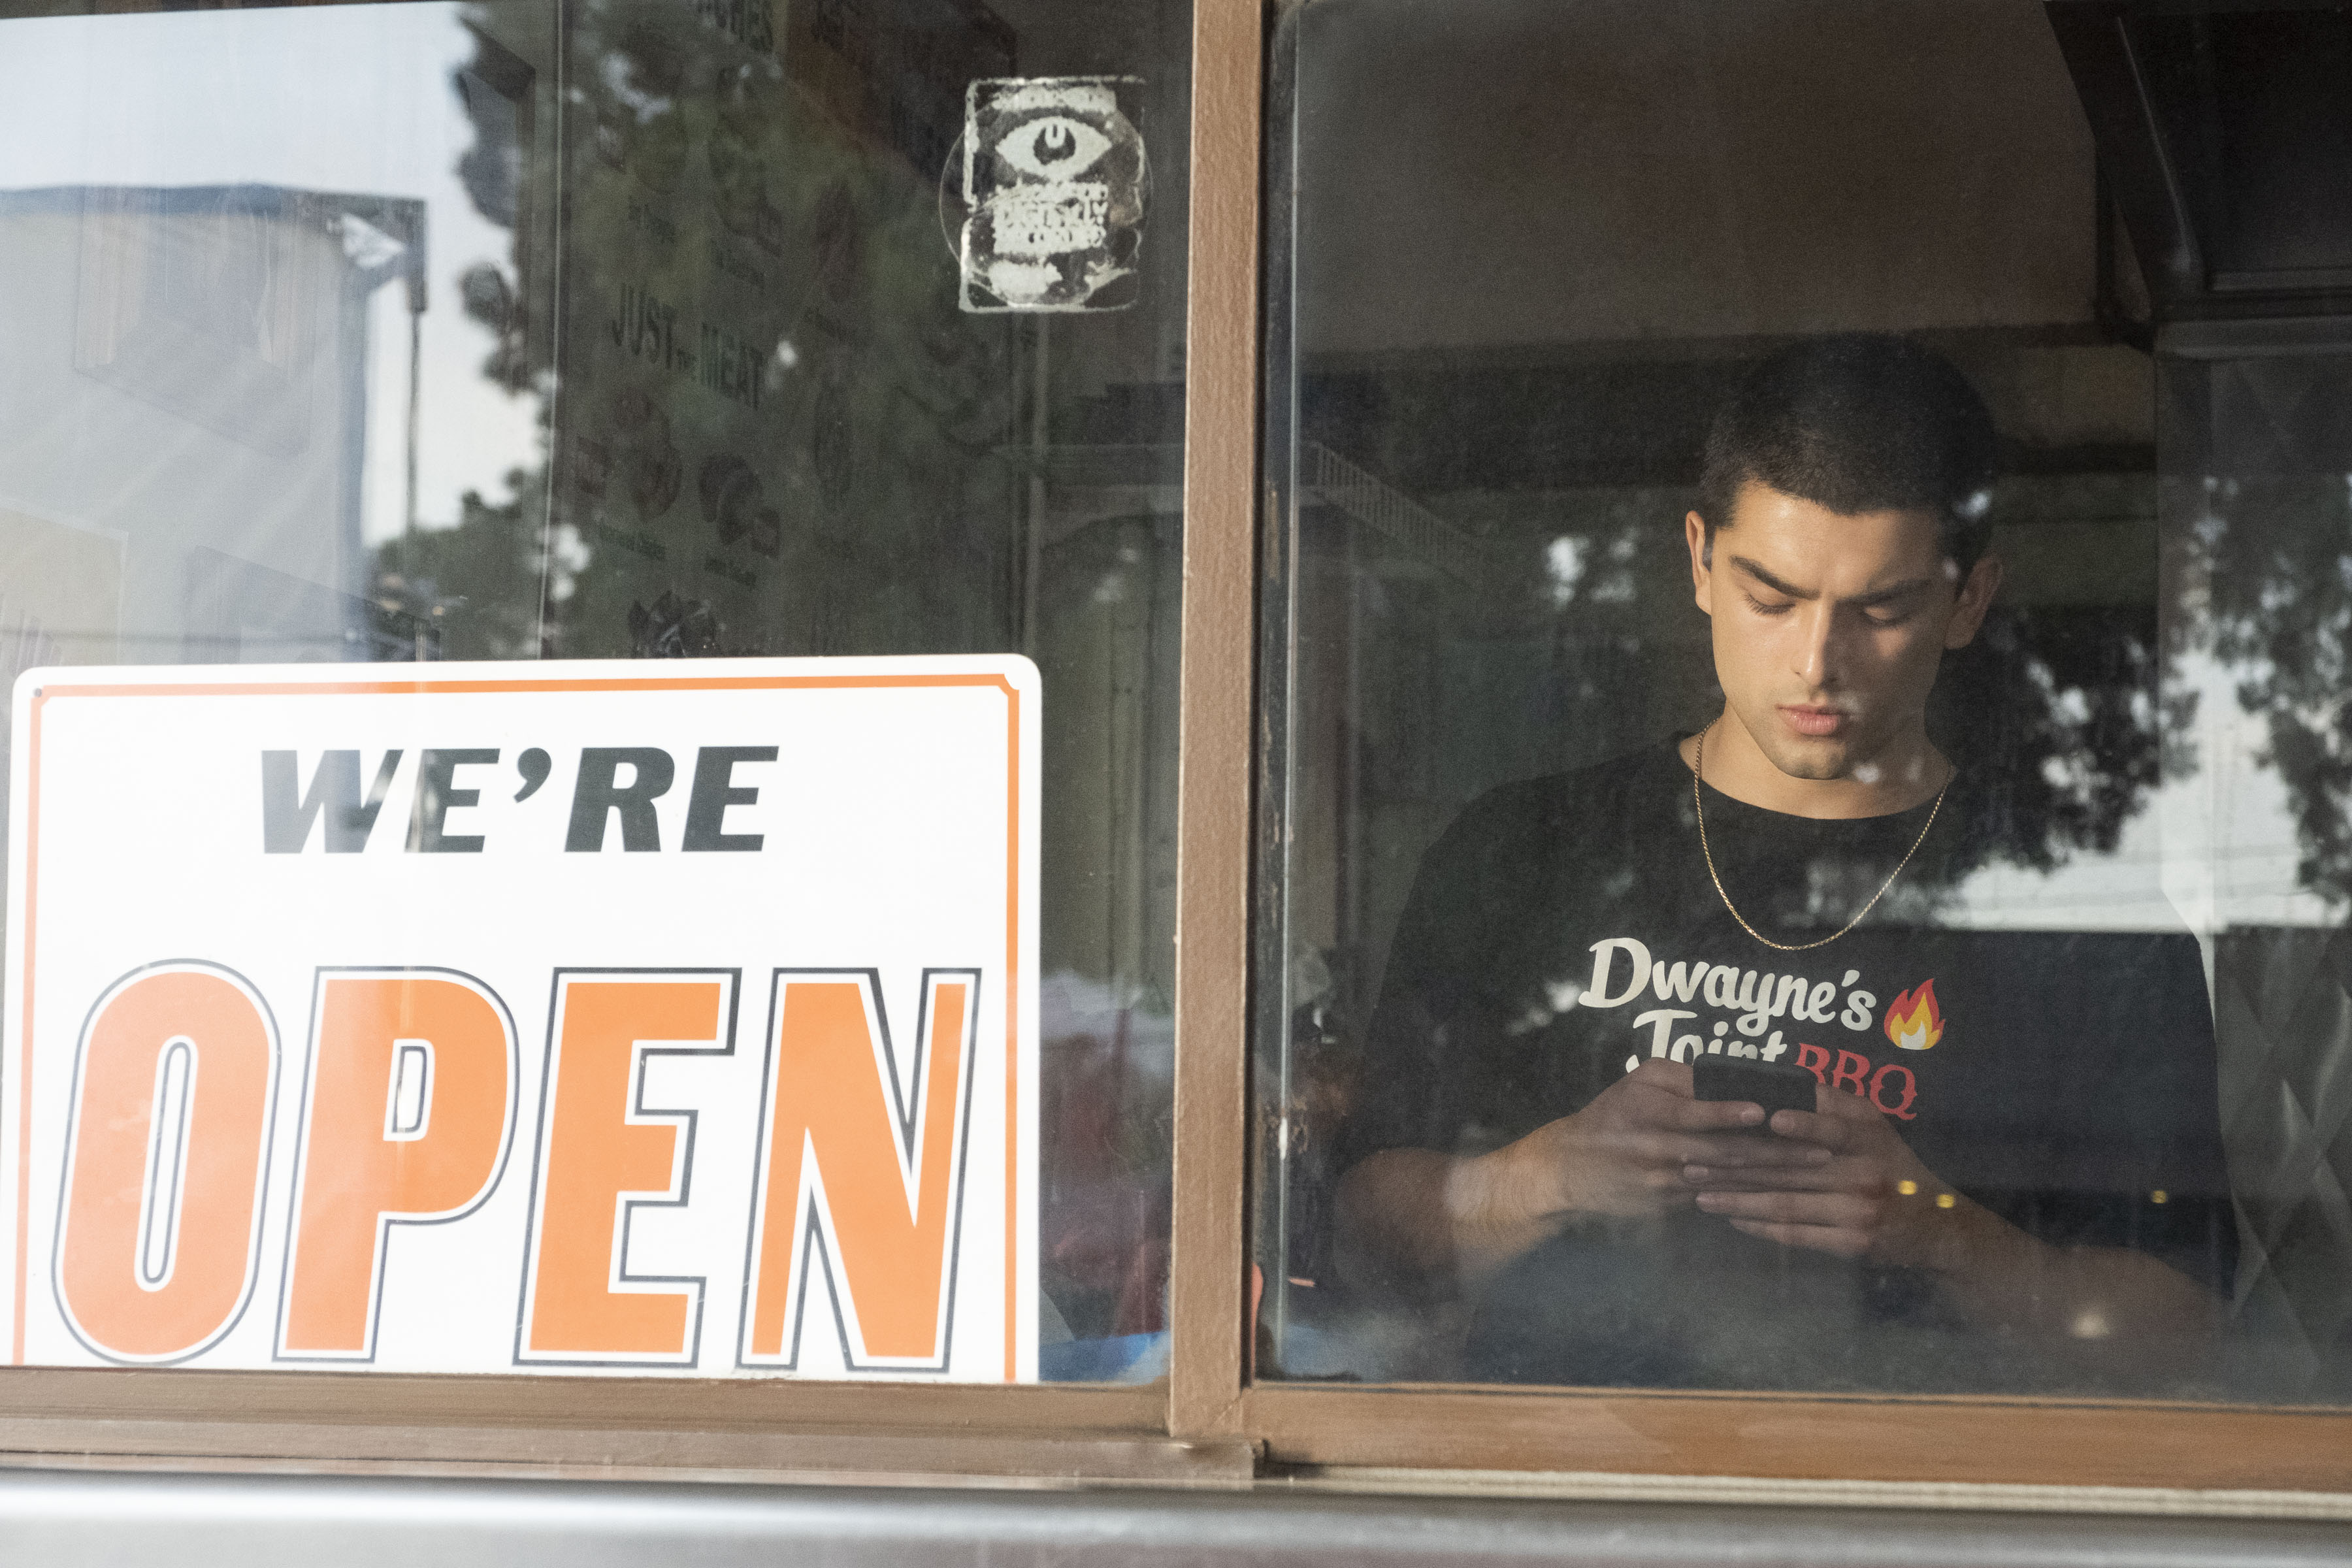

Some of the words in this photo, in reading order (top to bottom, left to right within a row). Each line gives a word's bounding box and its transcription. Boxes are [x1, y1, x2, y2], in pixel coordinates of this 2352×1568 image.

[612, 282, 678, 370] JUST
[700, 322, 764, 410] MEAT
[260, 745, 779, 854] WE'RE
[1578, 938, 1876, 1036] Dwayne's
[1795, 1043, 1918, 1120] BBQ
[52, 958, 982, 1373] OPEN
